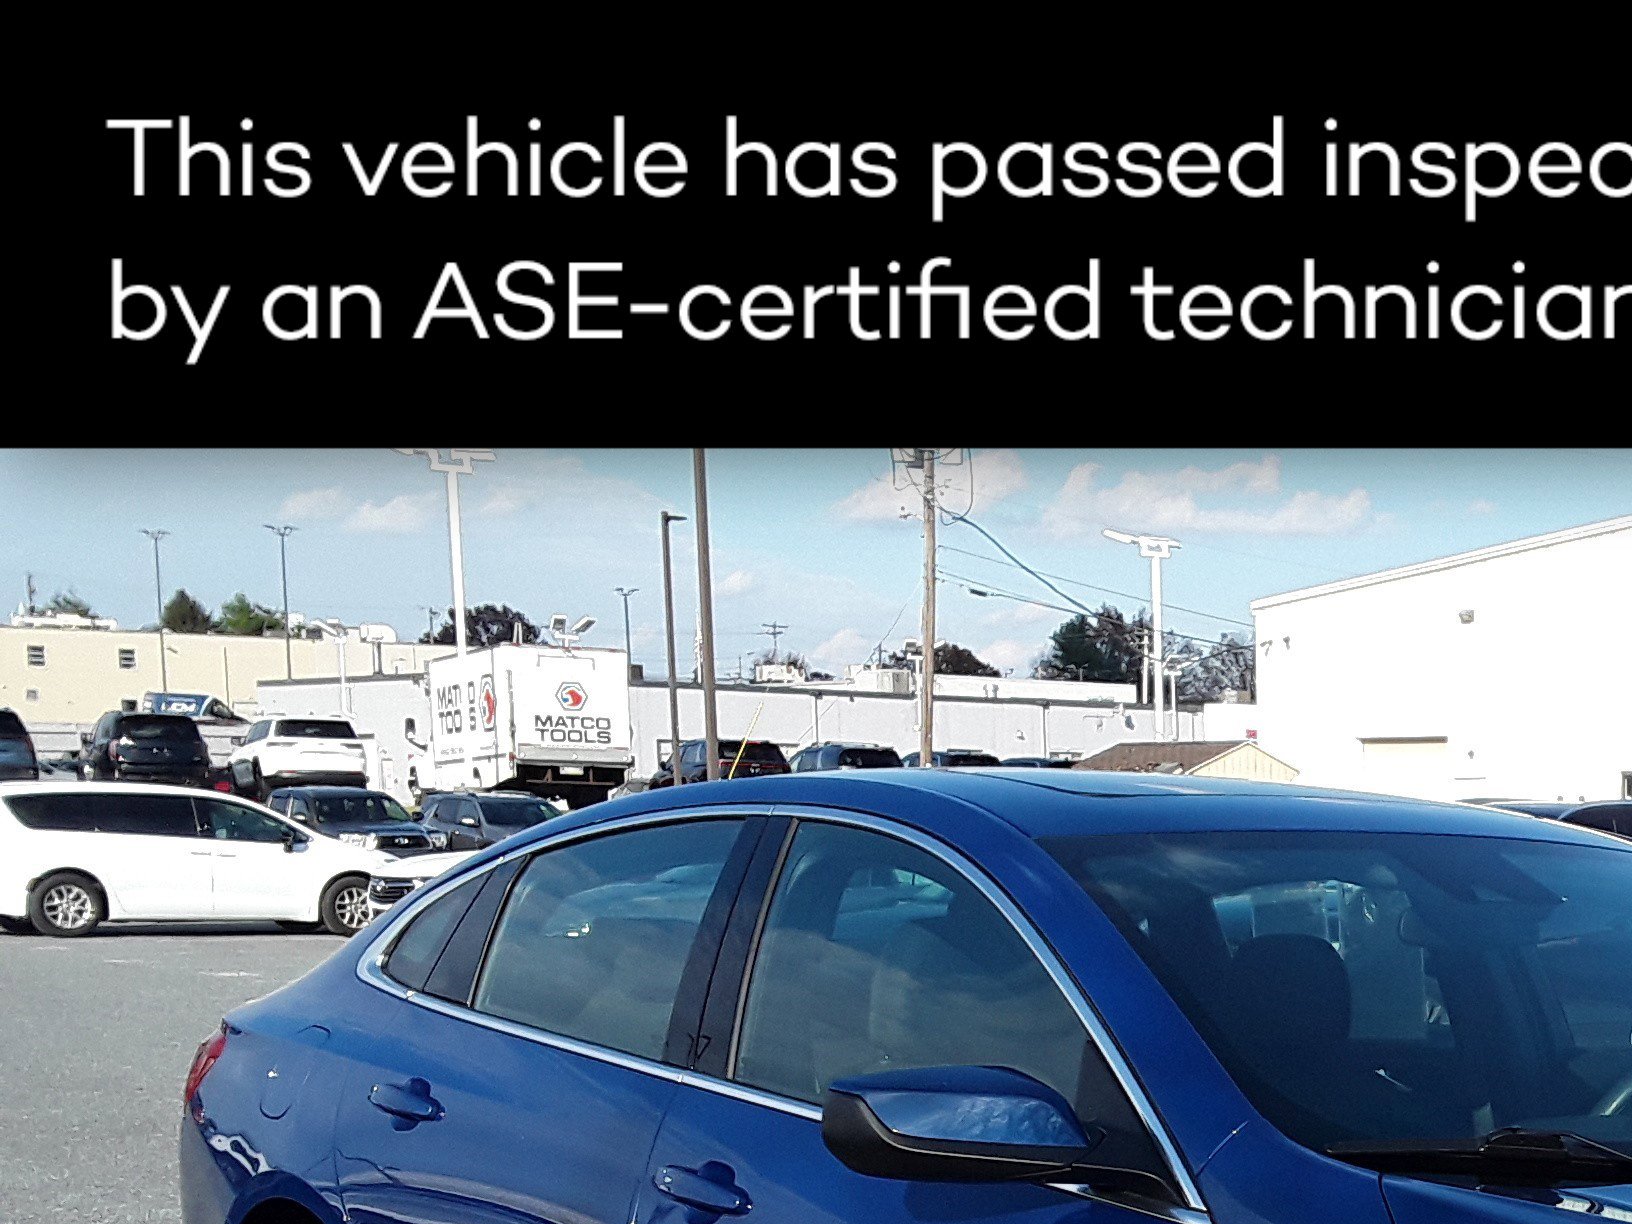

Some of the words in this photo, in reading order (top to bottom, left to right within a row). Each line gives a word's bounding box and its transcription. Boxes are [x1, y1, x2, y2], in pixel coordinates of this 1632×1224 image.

[437, 681, 475, 710] MATO
[438, 707, 476, 735] TOOS
[535, 715, 611, 730] MATCO
[535, 728, 611, 744] TOOLS
